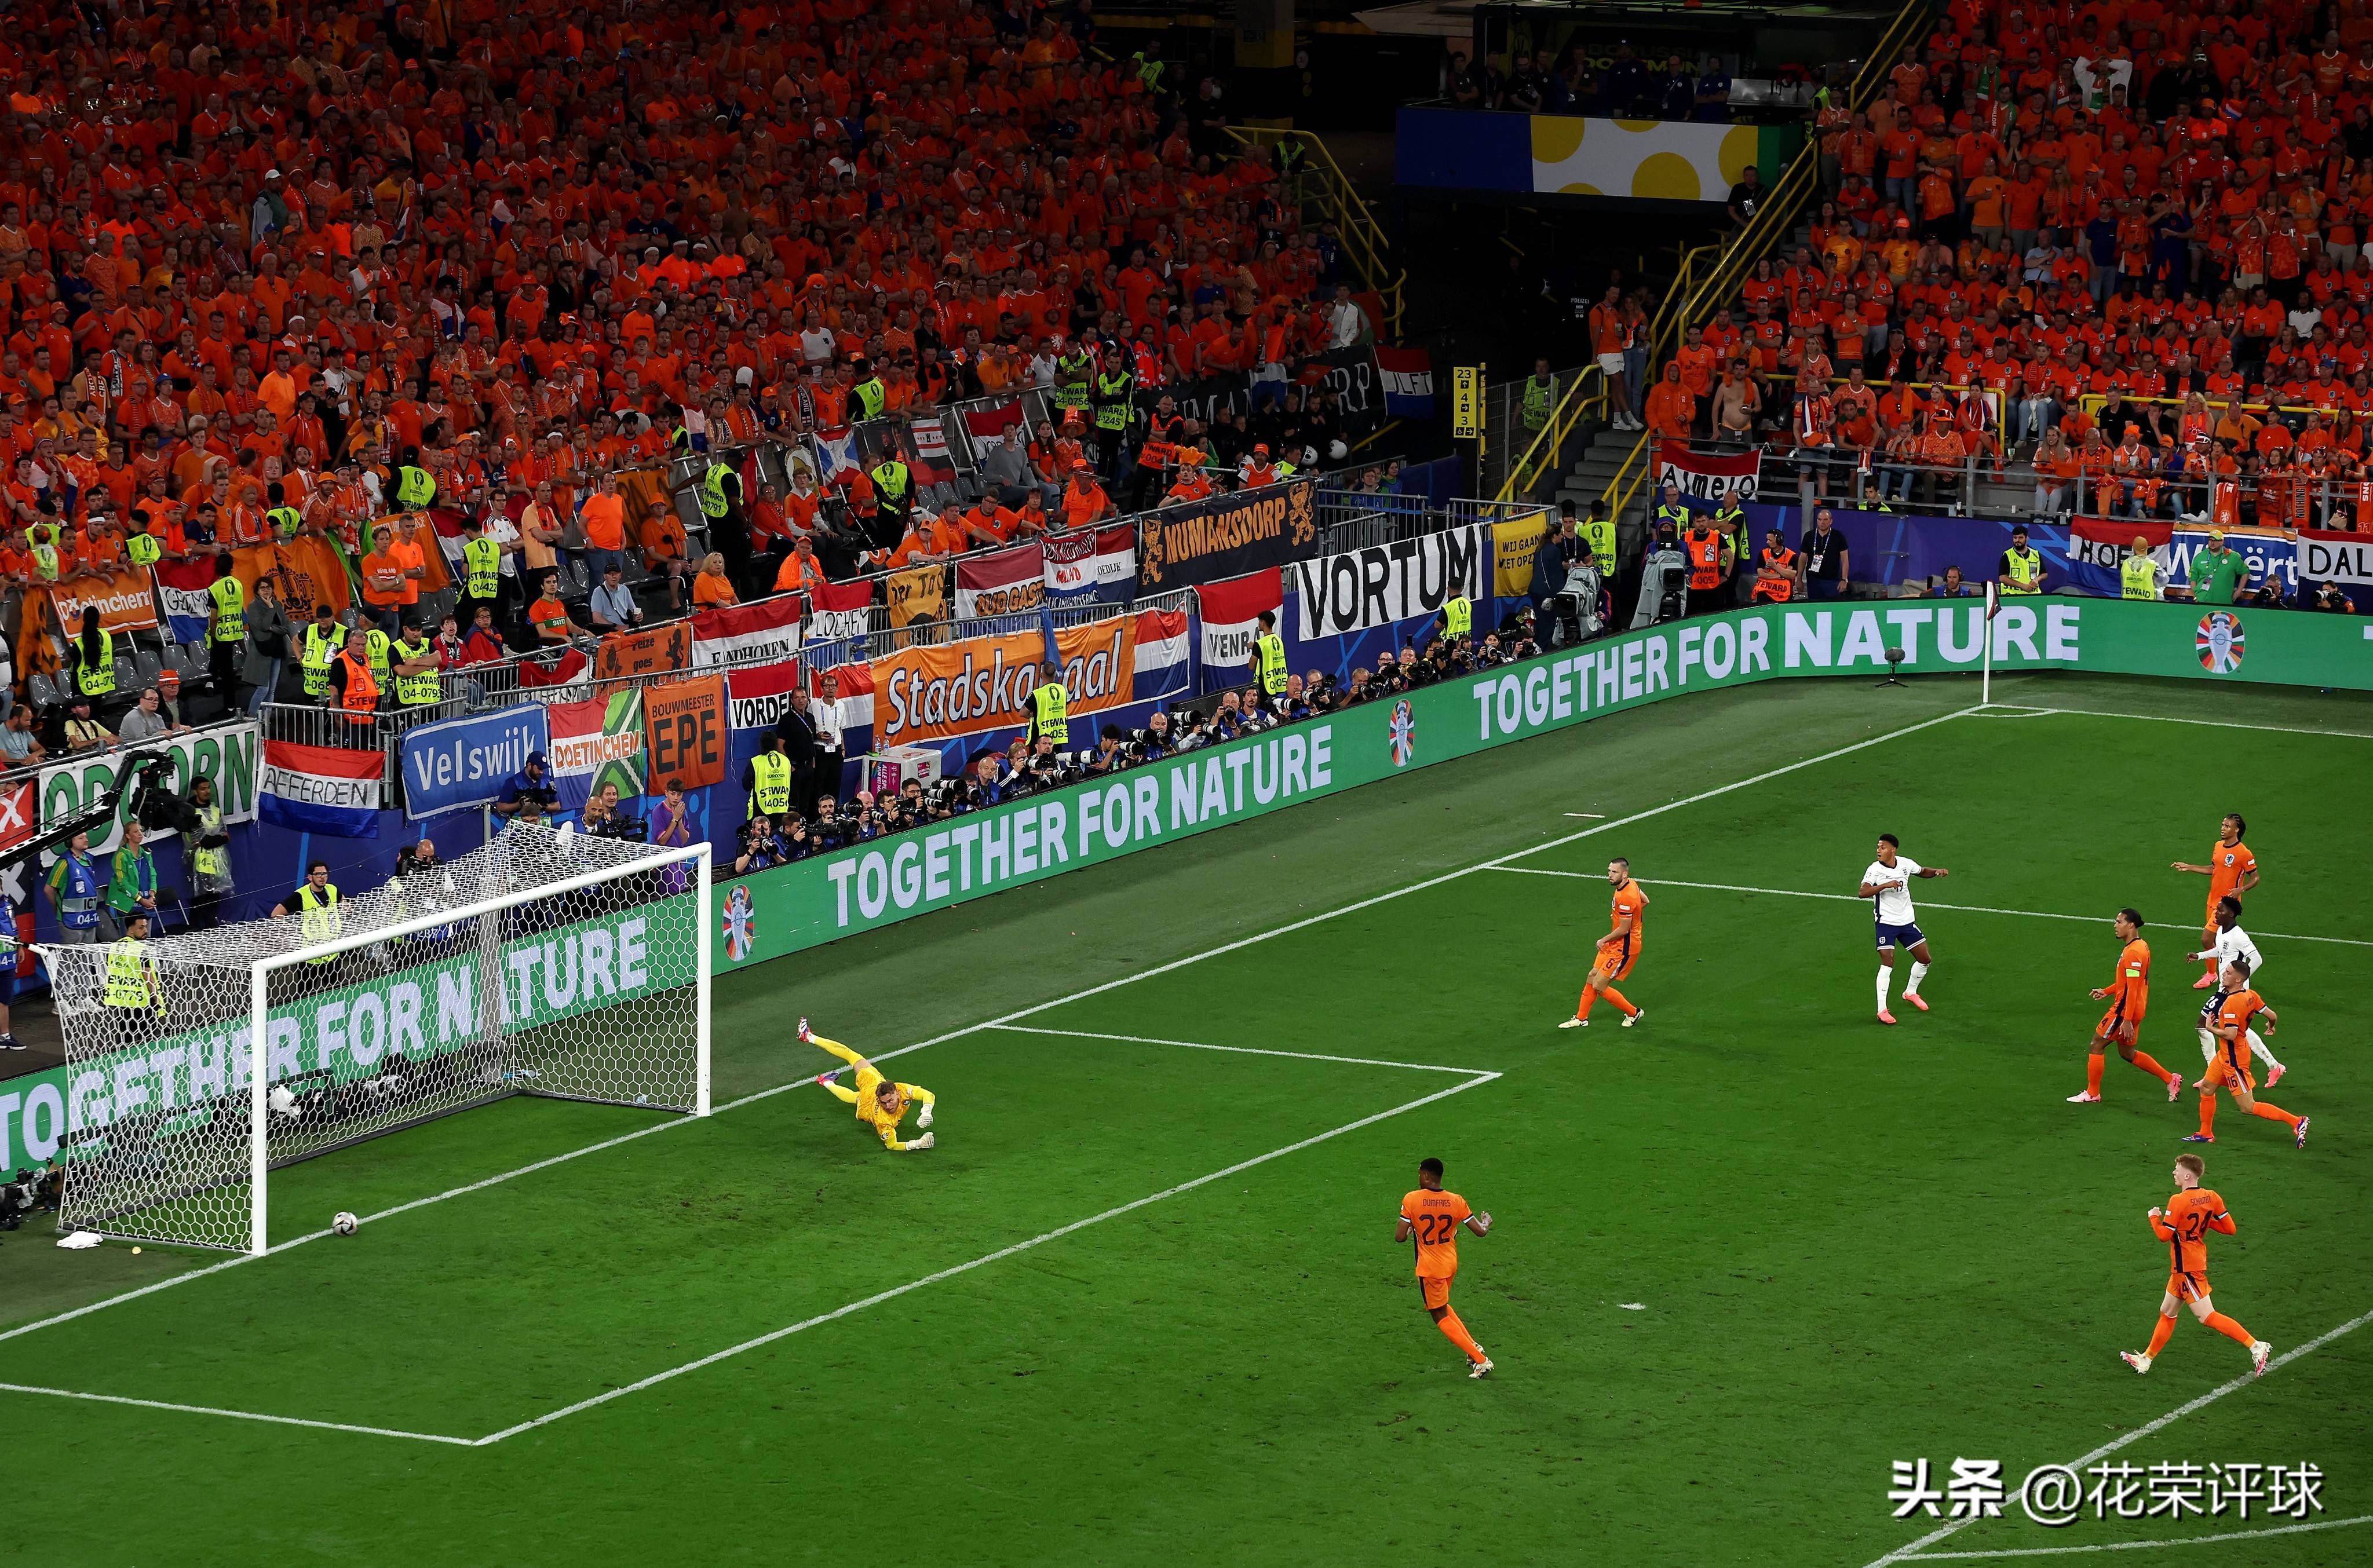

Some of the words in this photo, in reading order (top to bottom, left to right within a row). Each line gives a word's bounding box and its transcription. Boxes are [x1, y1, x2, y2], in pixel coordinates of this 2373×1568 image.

[1457, 370, 1471, 378] 23
[1461, 393, 1468, 402] 4
[1461, 416, 1468, 425] 3
[1164, 496, 1286, 565] NUMANSDORP
[1503, 540, 1517, 553] WIJ
[2079, 539, 2155, 569] HOE
[1097, 562, 1121, 576] OEDIJK
[2167, 542, 2298, 585] Wërt
[1299, 524, 1477, 638] VORTUM
[975, 590, 1008, 617] OUD
[633, 657, 652, 672] goes
[1473, 634, 1669, 741] TOGETHER
[1678, 617, 1771, 686] FOR
[1784, 604, 2080, 668] NATURE
[885, 628, 1122, 735] Stadskaaal
[652, 693, 714, 719] BOUWMEESTER
[733, 693, 791, 728] VORDE
[554, 730, 640, 769] DOETINCHEM
[652, 709, 718, 775] EPE
[414, 724, 540, 792] Velswijk
[264, 766, 368, 805] AFFERDEN
[827, 801, 1069, 927] TOGETHER
[1079, 775, 1161, 856] FOR
[1171, 724, 1331, 830] NATURE
[1605, 958, 1613, 969] 6
[2206, 996, 2218, 1008] 26
[317, 981, 425, 1083] FOR
[2228, 1076, 2239, 1088] 16
[1419, 1214, 1453, 1245] 22
